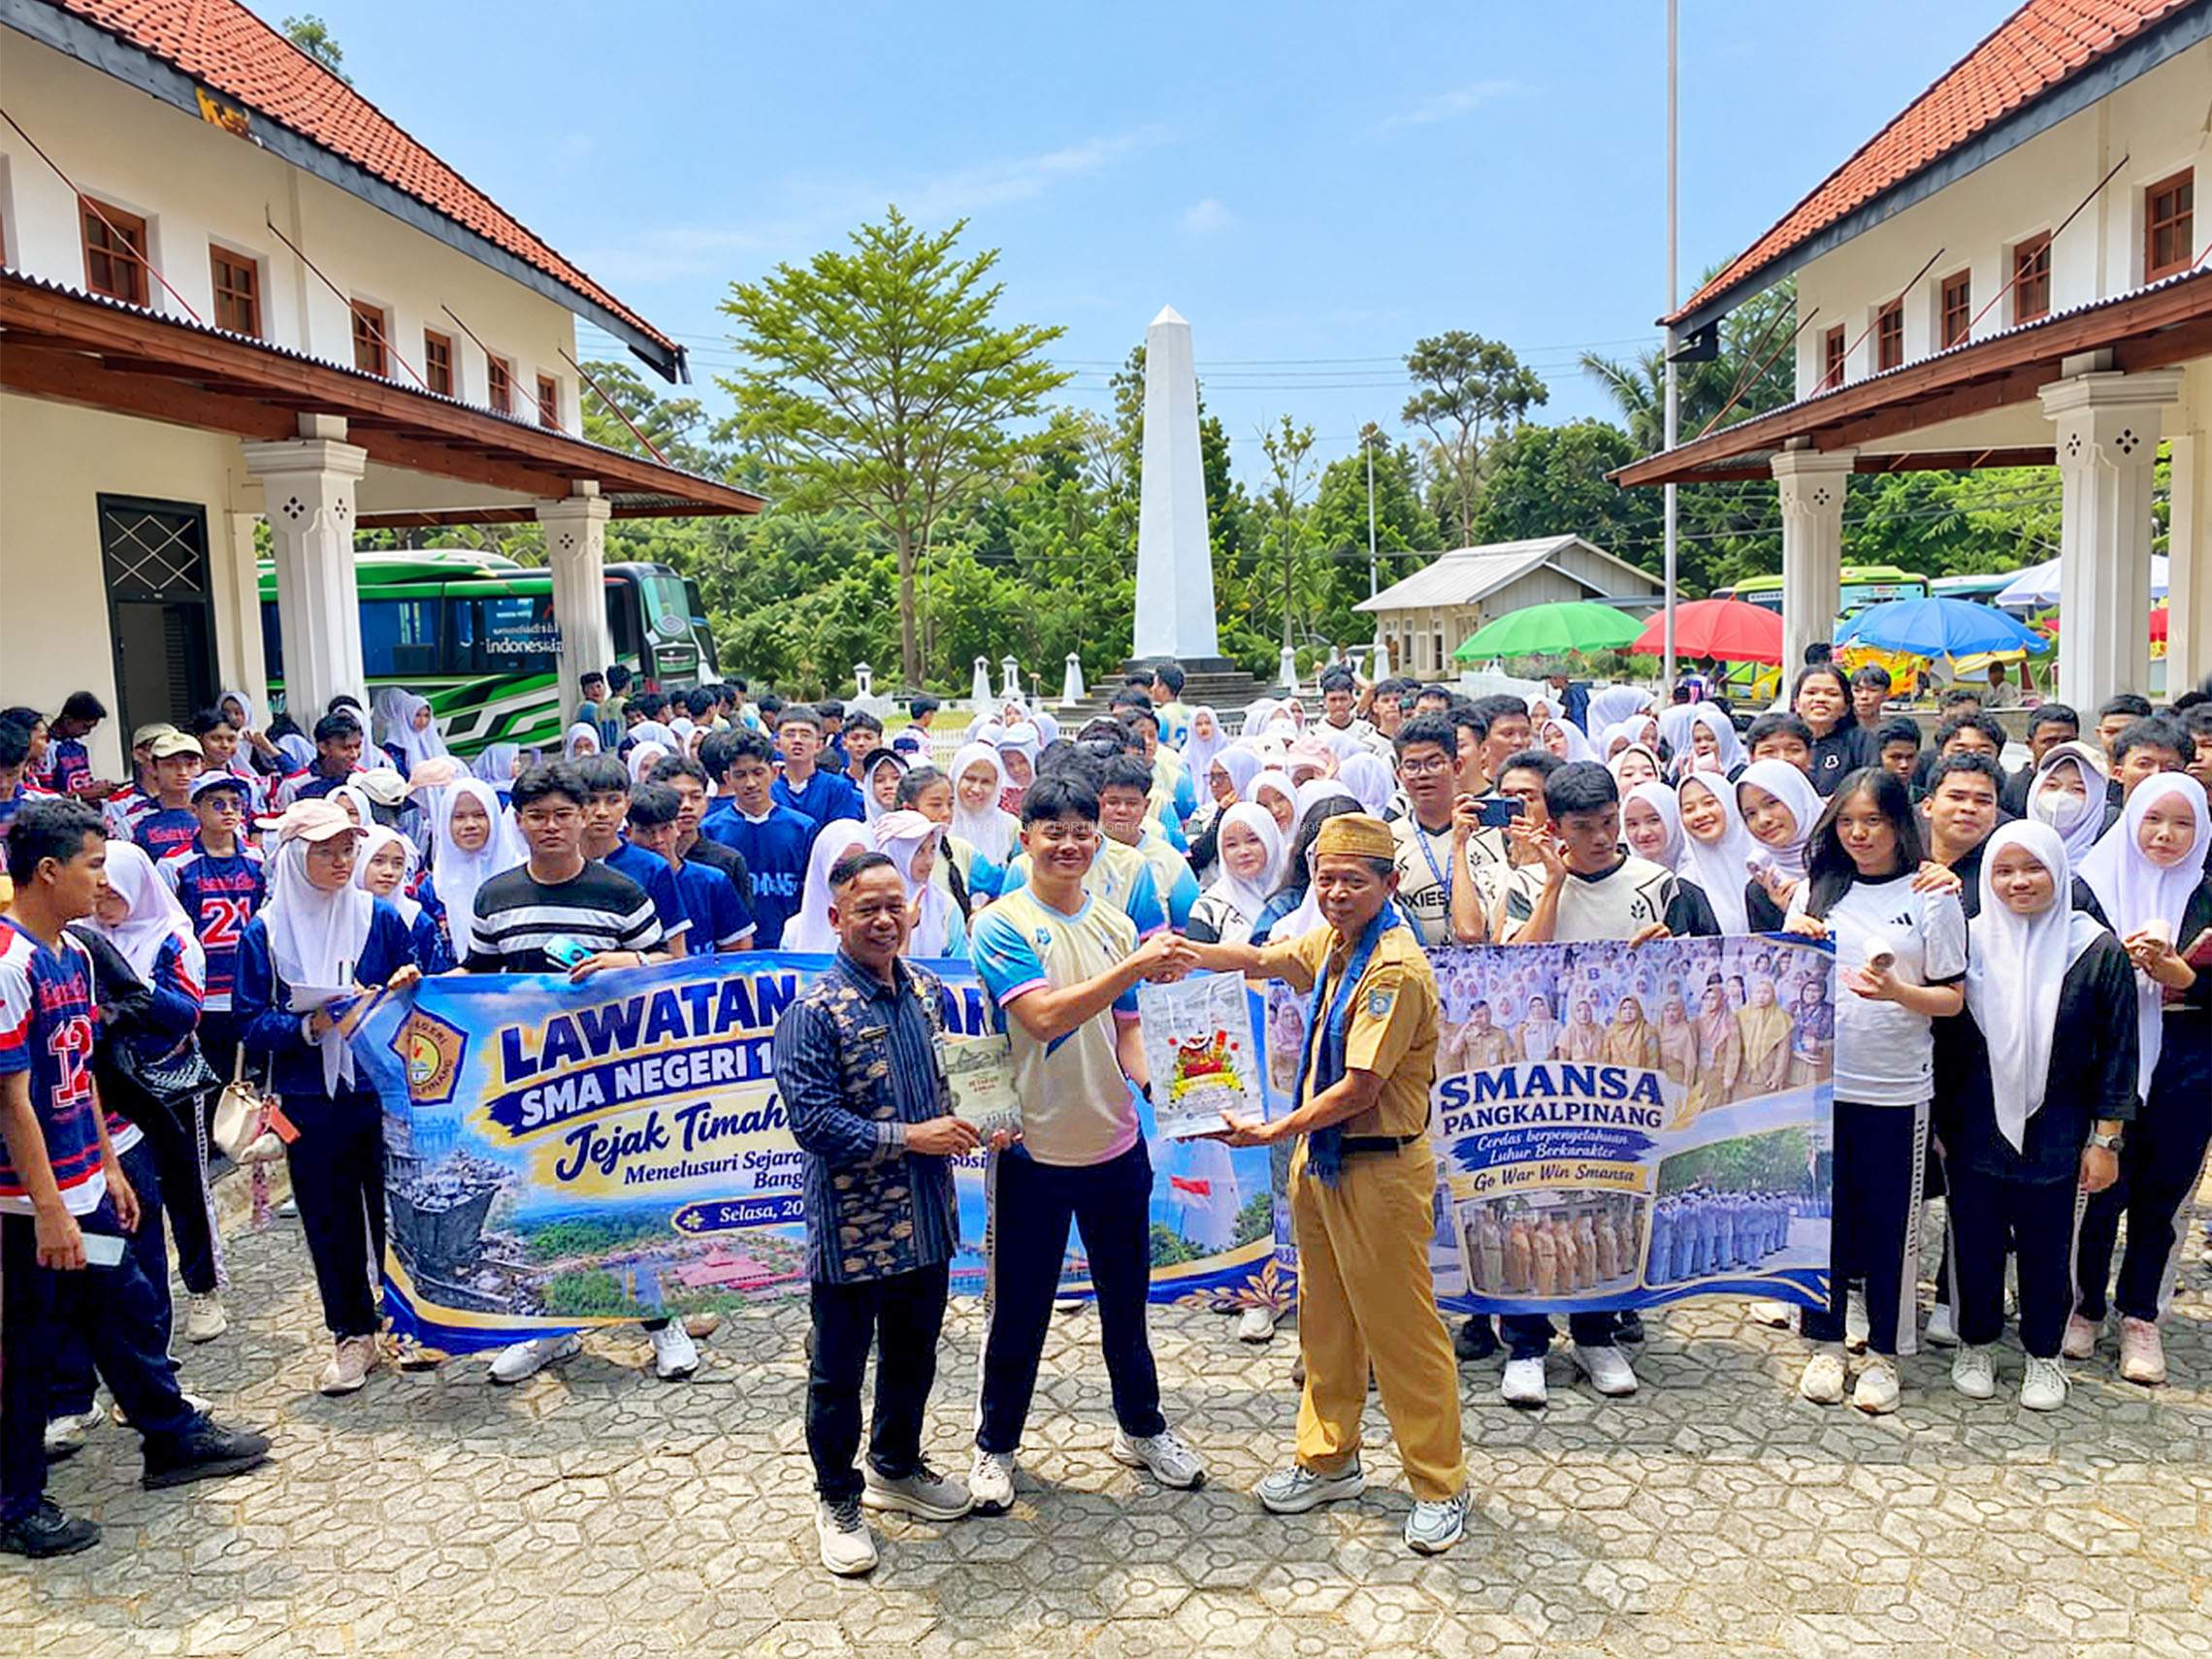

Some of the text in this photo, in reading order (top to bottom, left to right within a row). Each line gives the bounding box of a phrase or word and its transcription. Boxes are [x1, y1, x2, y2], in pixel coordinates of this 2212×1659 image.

[501, 974, 797, 1085] LAWATAN
[521, 1042, 772, 1126] SMA NEGERI 1
[1439, 1064, 1665, 1114] SMANSA
[1444, 1102, 1662, 1136] PANGKALPINANG
[555, 1110, 669, 1182] Jejak
[1477, 1133, 1521, 1153] Cerdas
[1490, 1148, 1530, 1164] Luhur
[624, 1154, 738, 1185] Menelusuri
[1474, 1164, 1635, 1191] Go War Win Smansa
[719, 1204, 778, 1222] Selasa,
